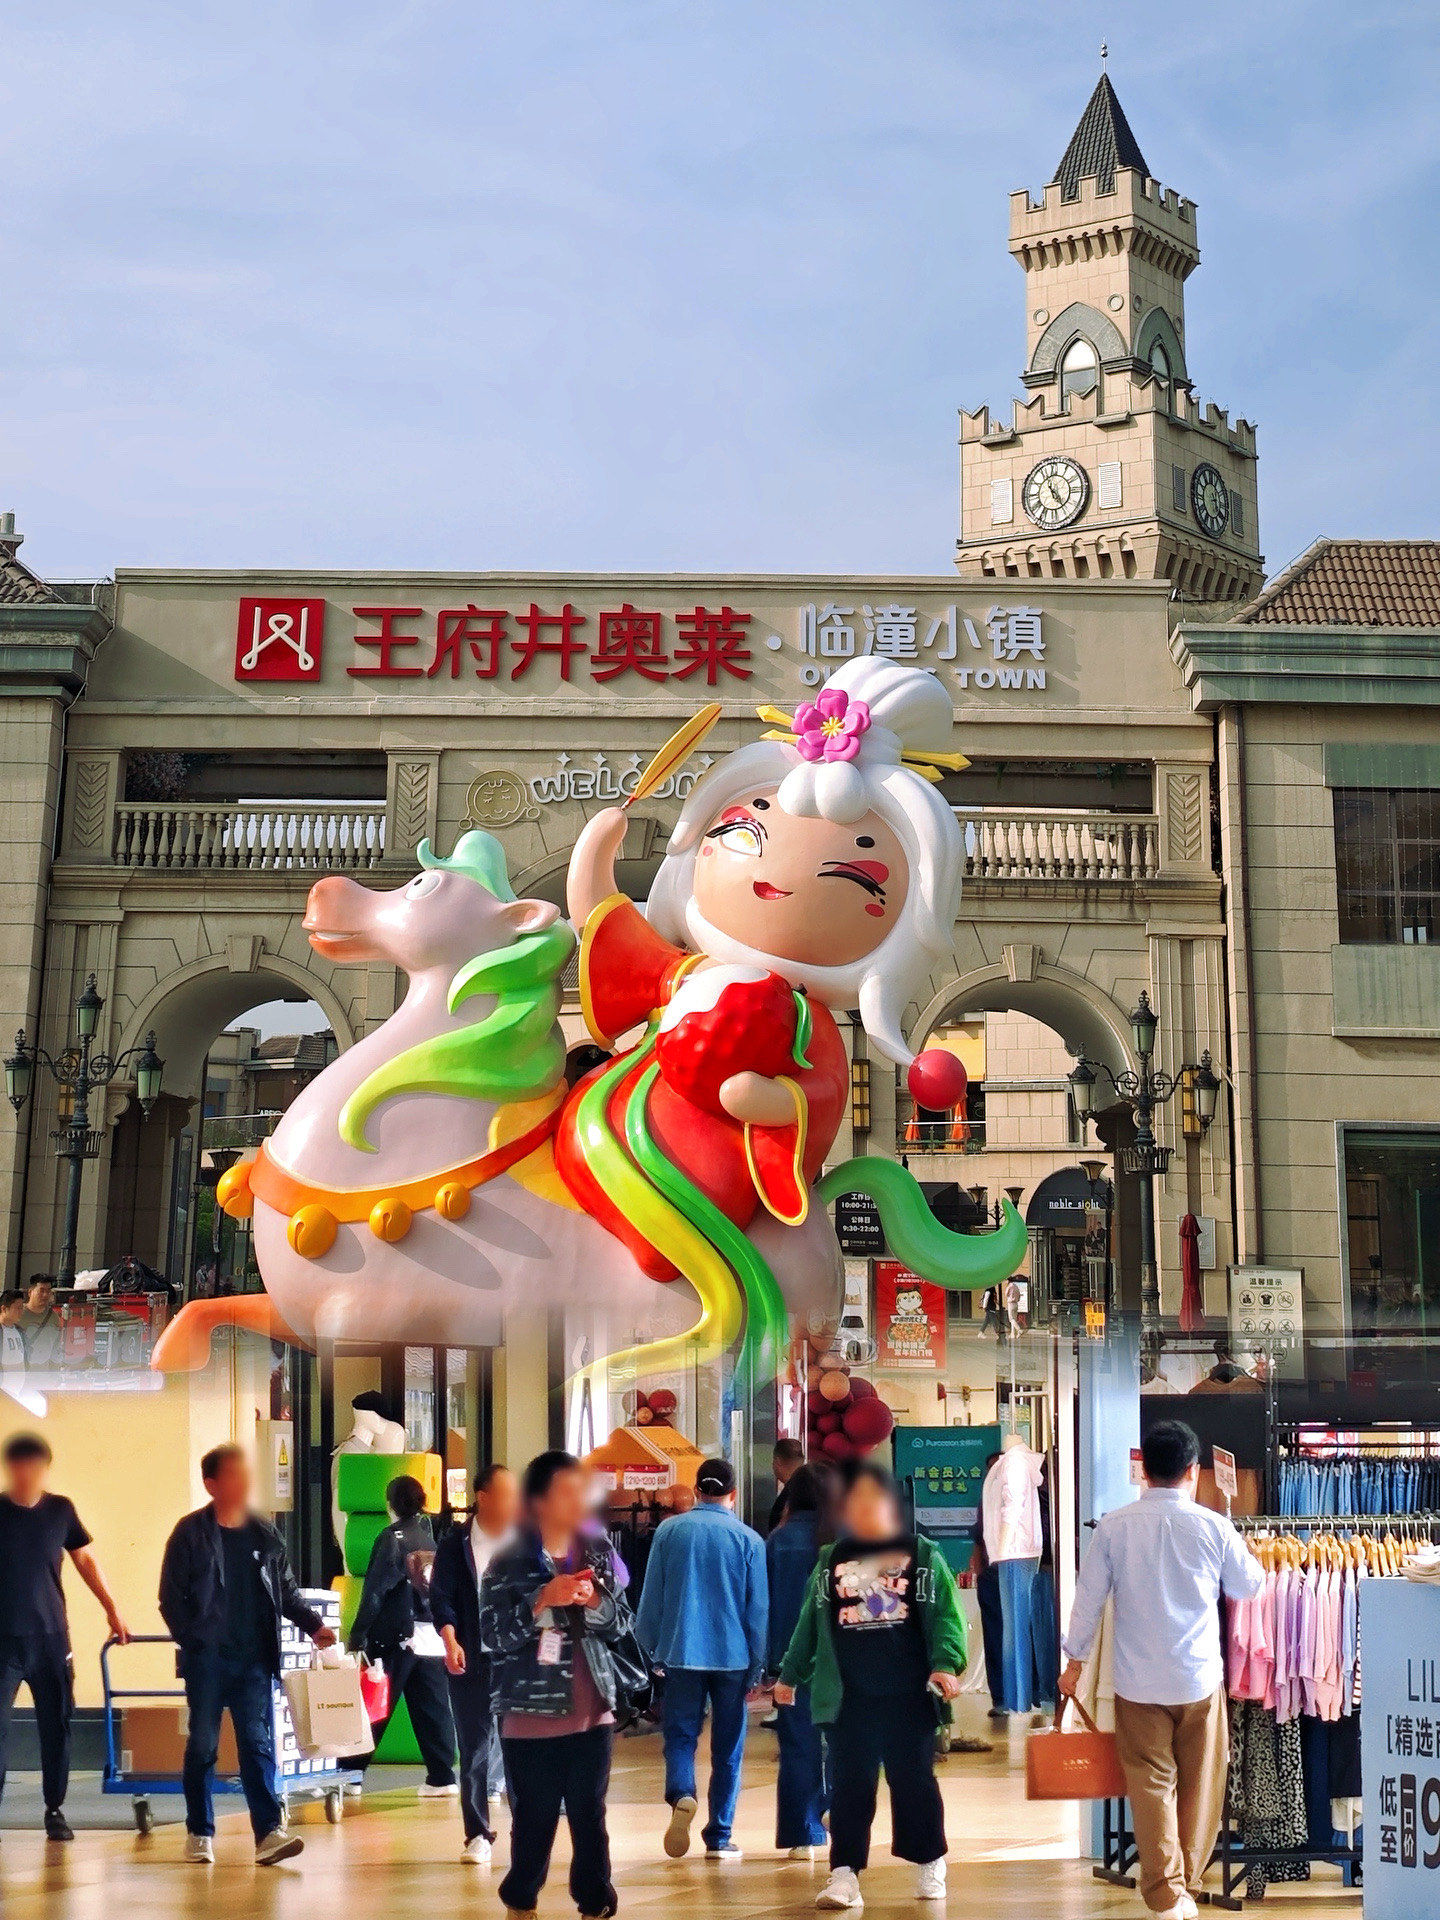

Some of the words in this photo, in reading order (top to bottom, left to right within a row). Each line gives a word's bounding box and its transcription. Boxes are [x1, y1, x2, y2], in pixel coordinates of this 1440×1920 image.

[955, 667, 1047, 691] TOWN
[1049, 1197, 1073, 1208] noble
[842, 1225, 880, 1233] 9:30-22:00
[1249, 1277, 1283, 1286] 温馨提示
[914, 1466, 982, 1479] 新会员入会
[1380, 1774, 1398, 1864] 低至
[1402, 1788, 1415, 1858] 一口价
